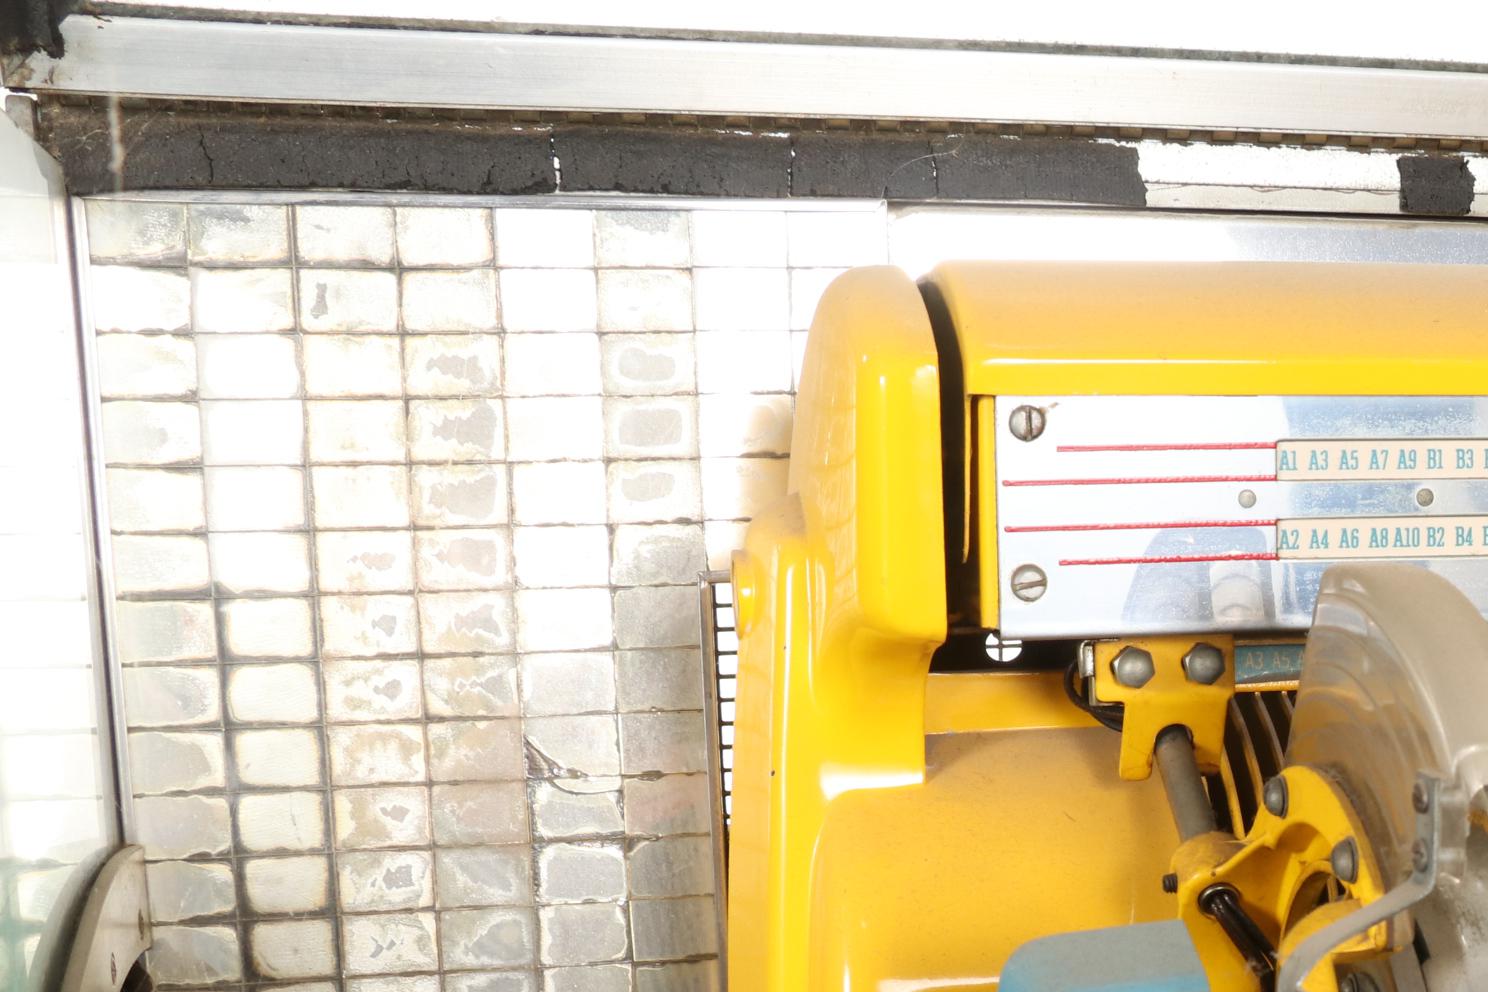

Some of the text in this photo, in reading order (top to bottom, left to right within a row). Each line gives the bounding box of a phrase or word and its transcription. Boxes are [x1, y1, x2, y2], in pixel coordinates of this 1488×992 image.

[1278, 449, 1298, 472] A1
[1308, 450, 1329, 471] A3
[1339, 449, 1360, 471] A5
[1369, 449, 1390, 471] A7
[1397, 449, 1418, 471] A9
[1427, 448, 1444, 470] B1
[1456, 448, 1475, 470] B3
[1279, 529, 1300, 551] A2
[1309, 528, 1330, 550] A4
[1339, 527, 1360, 550] A6
[1368, 527, 1390, 549] A8
[1392, 527, 1421, 549] A10
[1426, 526, 1446, 548] B2
[1455, 526, 1474, 548] B4
[1245, 650, 1265, 670] A3
[1272, 650, 1291, 670] A5
